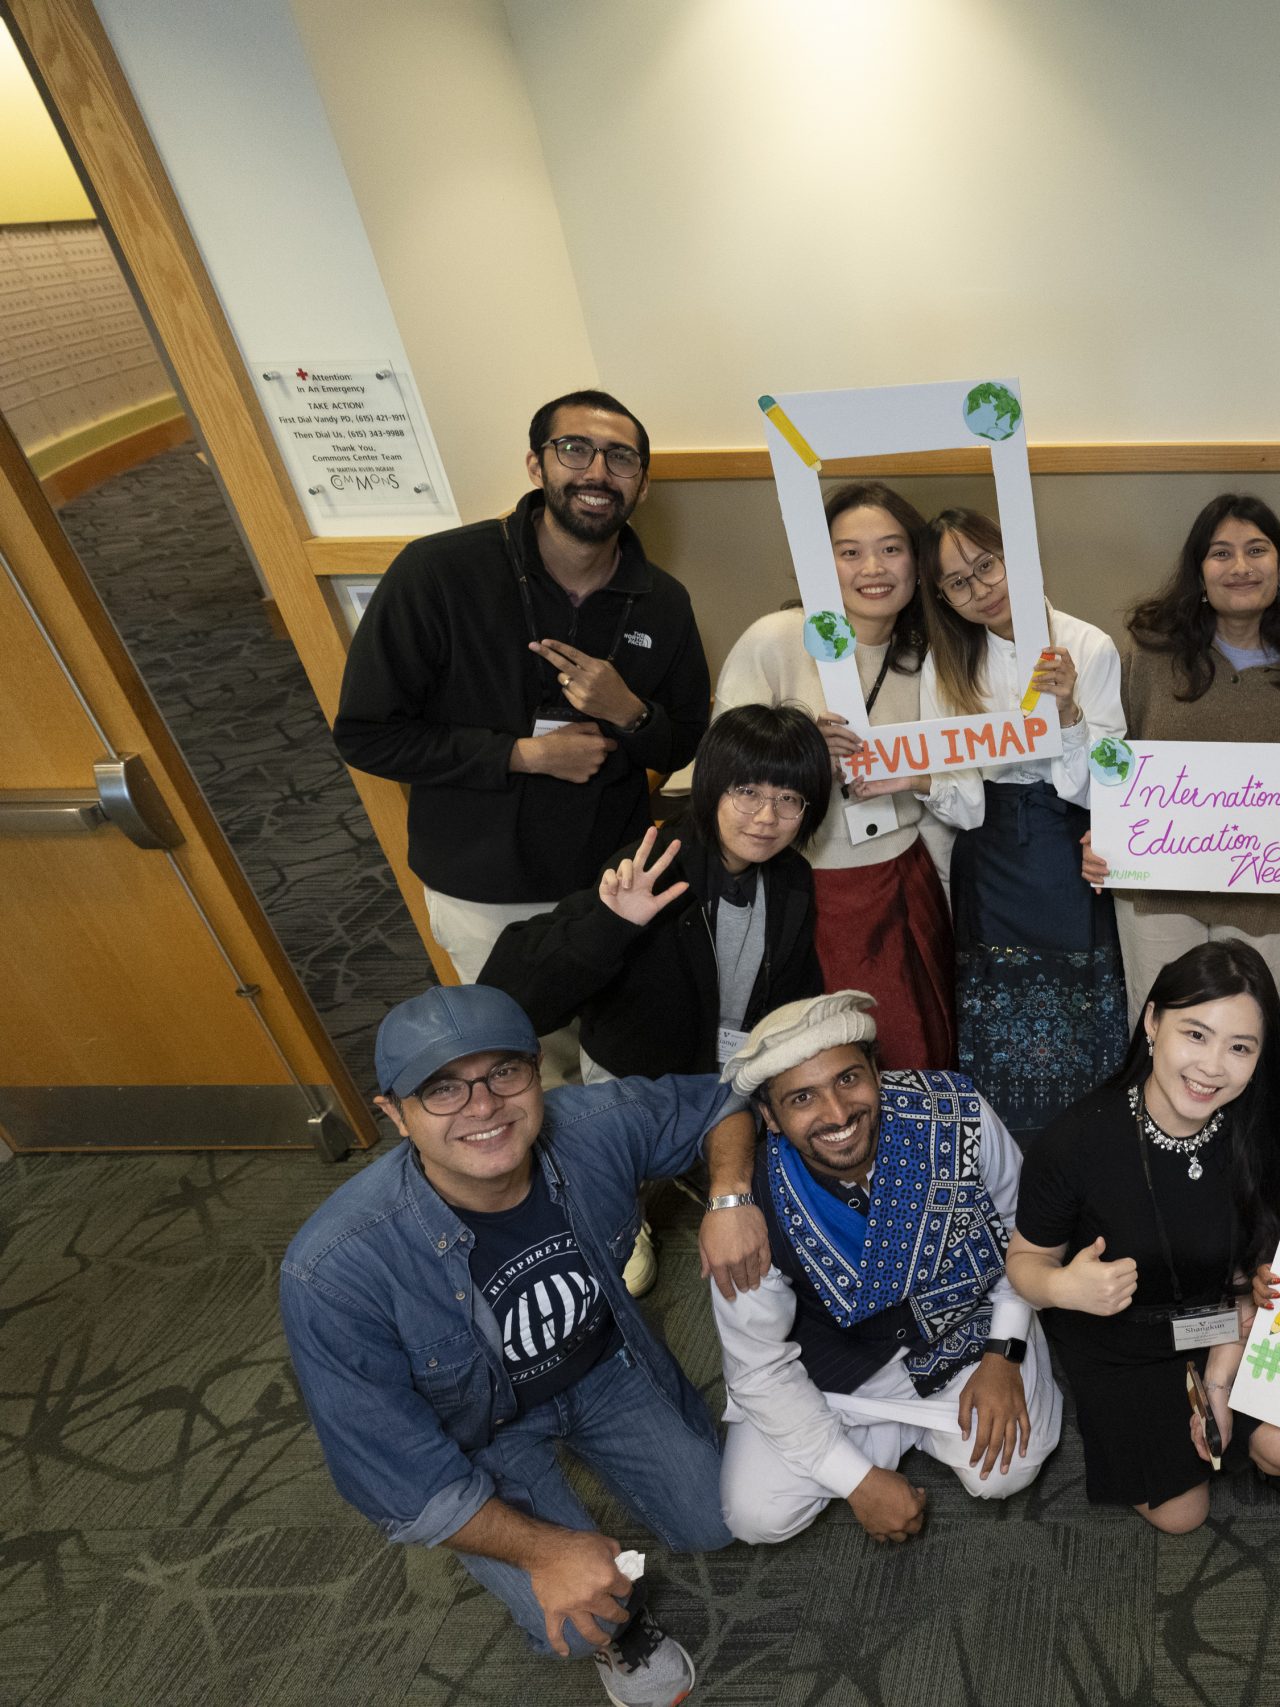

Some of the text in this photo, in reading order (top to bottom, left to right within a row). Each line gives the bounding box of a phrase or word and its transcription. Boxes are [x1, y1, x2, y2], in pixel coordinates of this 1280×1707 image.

[312, 373, 352, 381] Attention:
[321, 386, 365, 394] Emergency
[307, 402, 329, 410] TAKE
[278, 416, 296, 424] First
[297, 416, 312, 424] Dial
[313, 415, 338, 425] Vandy
[355, 413, 374, 423] (615)
[376, 413, 406, 422] 421-1911
[293, 431, 314, 439] Then
[315, 430, 330, 439] Dial
[347, 429, 367, 439] (615)
[369, 429, 405, 438] 343-9988
[331, 443, 356, 452] Thank
[312, 454, 351, 462] Commons
[352, 453, 378, 461] Center
[840, 717, 1048, 778] #VU IMAP
[1127, 818, 1261, 857] Education
[489, 1241, 561, 1296] HUMPHREY
